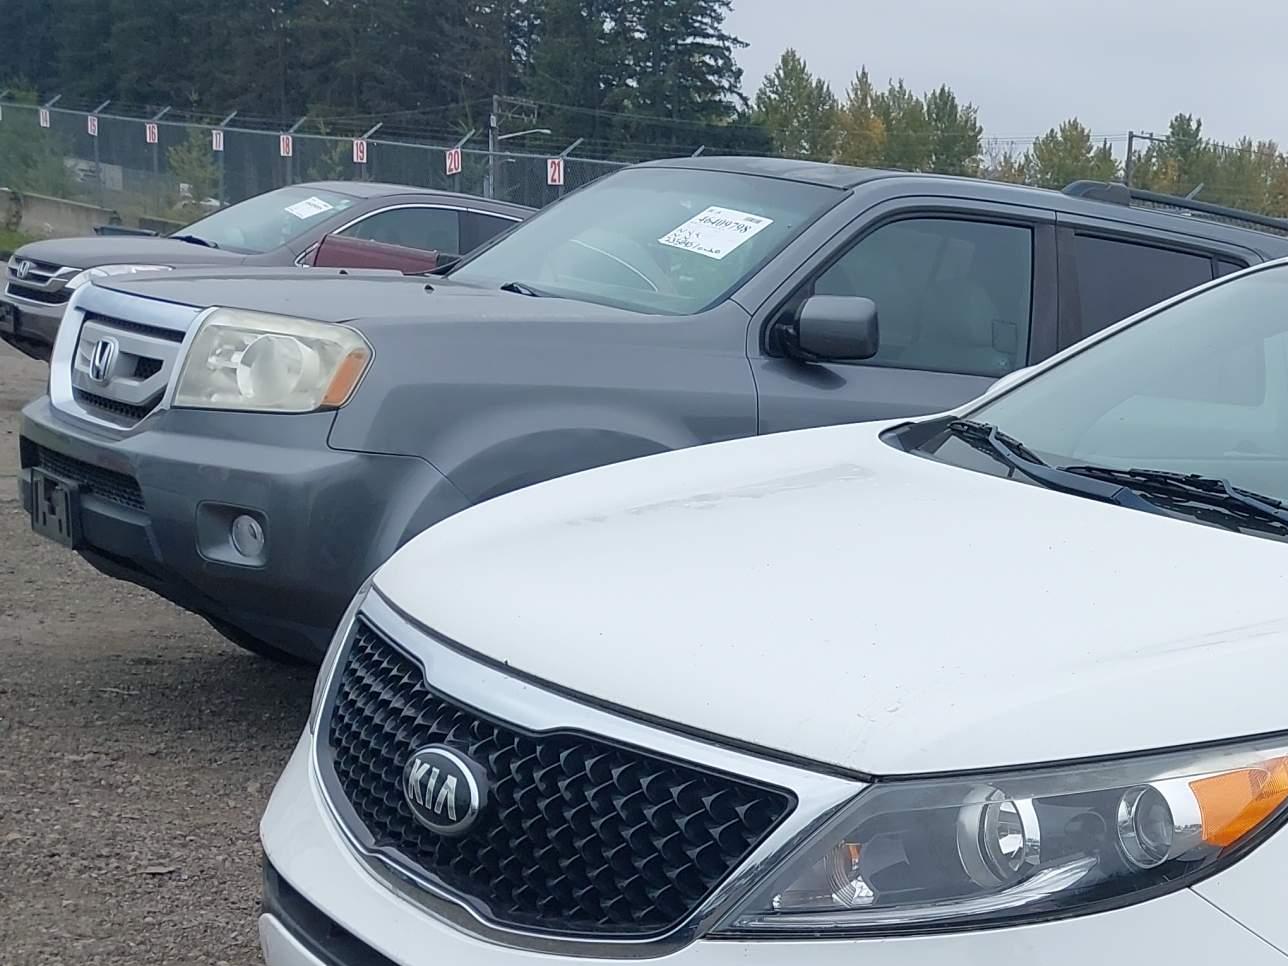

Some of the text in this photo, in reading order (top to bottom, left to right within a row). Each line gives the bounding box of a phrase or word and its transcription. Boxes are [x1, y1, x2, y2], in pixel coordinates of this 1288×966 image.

[148, 125, 156, 141] 16
[281, 135, 291, 155] 18
[355, 140, 365, 161] 19
[447, 151, 460, 173] 20
[550, 161, 561, 183] 21
[408, 758, 457, 821] KIA
